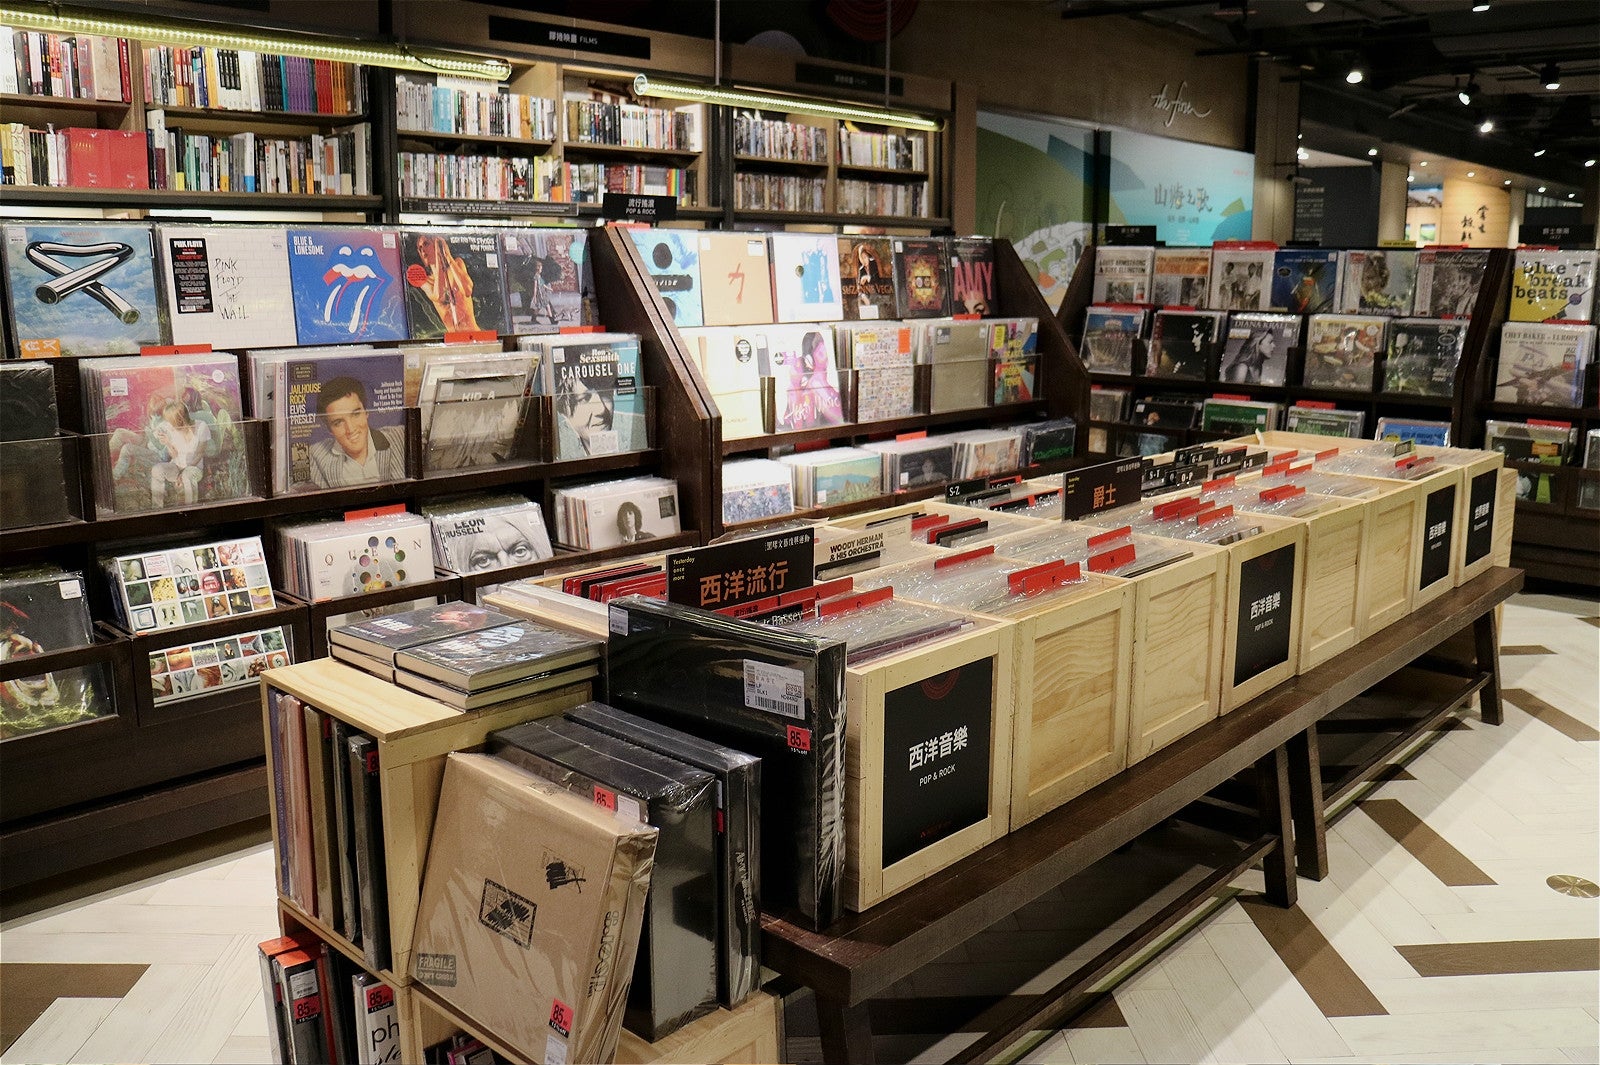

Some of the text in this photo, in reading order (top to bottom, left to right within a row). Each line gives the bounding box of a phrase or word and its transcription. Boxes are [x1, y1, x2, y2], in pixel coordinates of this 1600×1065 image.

[579, 35, 598, 45] FILMS
[293, 236, 308, 245] BLUE
[294, 245, 324, 256] LONESOME
[1521, 261, 1566, 275] blue
[954, 261, 993, 300] AMY
[1530, 274, 1587, 288] break
[876, 284, 894, 295] VEGA
[1514, 286, 1568, 300] beats
[562, 362, 636, 380] CAROUSEL ONE
[290, 383, 321, 395] JAILHOUSE
[462, 390, 496, 402] KID A
[290, 394, 306, 405] ROCK
[290, 404, 306, 414] ELVIS
[290, 414, 316, 426] PRESLEY
[1093, 483, 1117, 510] 爵士
[454, 517, 486, 530] LEON
[444, 526, 484, 539] RUSSELL
[830, 532, 884, 553] WOODY HERMAN
[830, 541, 884, 562] & HIS ORCHESTRA
[672, 557, 695, 566] Yesterday
[672, 574, 685, 582] more
[700, 560, 788, 606] 西洋流行
[1250, 592, 1281, 620] 西洋音樂
[772, 611, 802, 626] Bassey
[908, 725, 968, 771] 西洋音樂
[920, 773, 933, 786] POP
[938, 765, 956, 779] ROCK
[419, 956, 454, 970] FRAGILE
